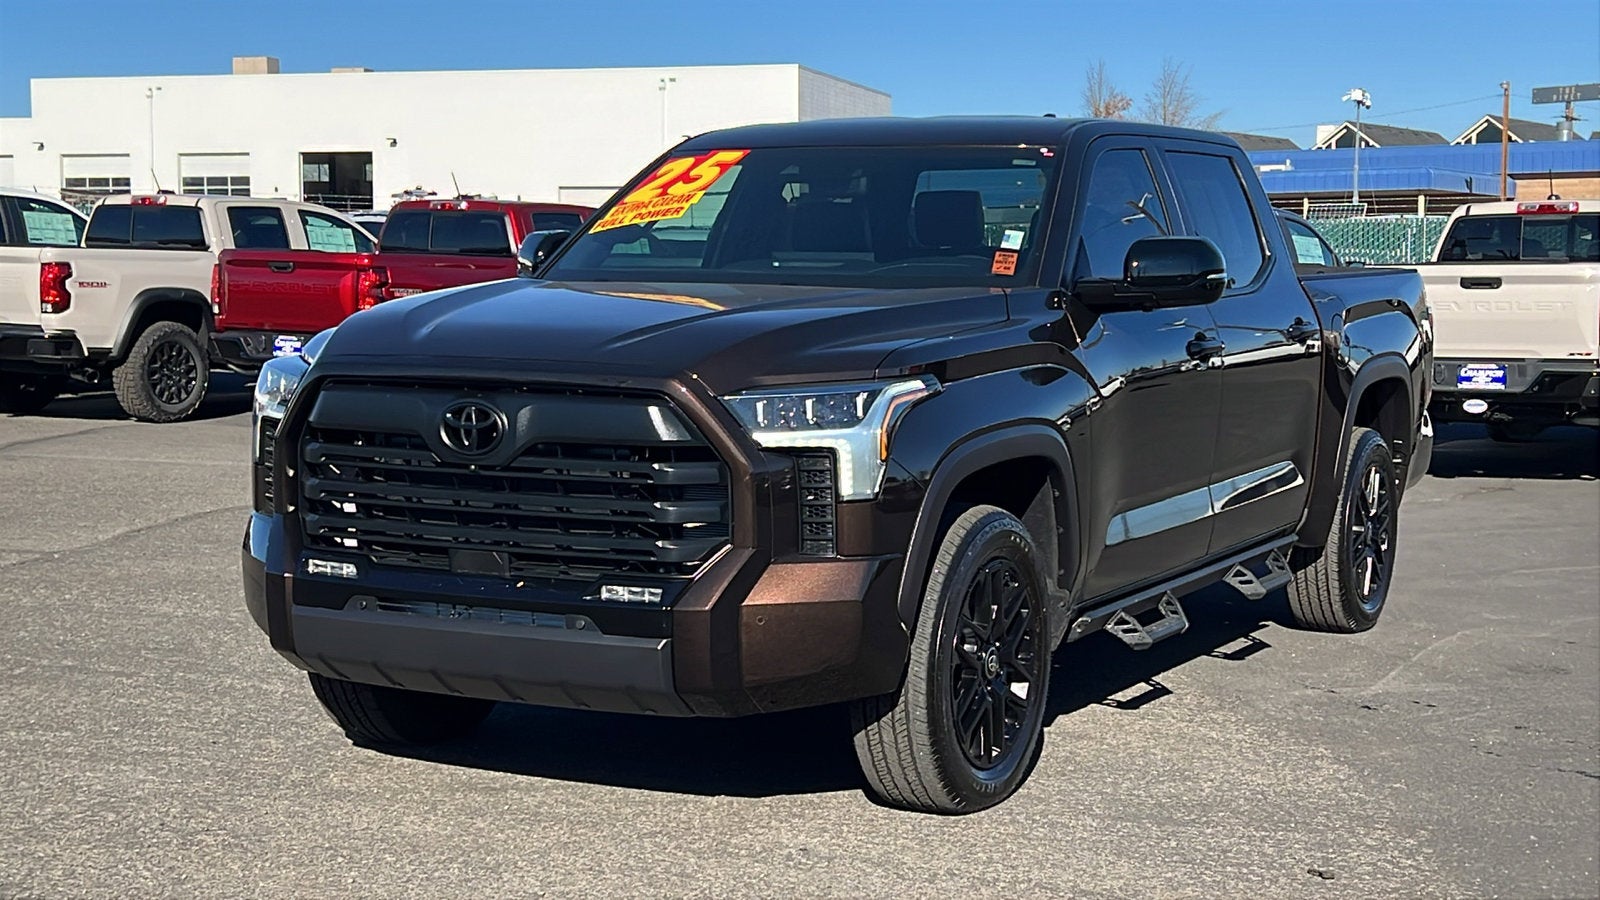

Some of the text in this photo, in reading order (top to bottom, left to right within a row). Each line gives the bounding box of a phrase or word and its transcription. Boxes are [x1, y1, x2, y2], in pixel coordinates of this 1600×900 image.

[623, 151, 744, 203] 25
[609, 193, 696, 216] EXTRA CLEAN
[593, 206, 685, 229] FULL POWER
